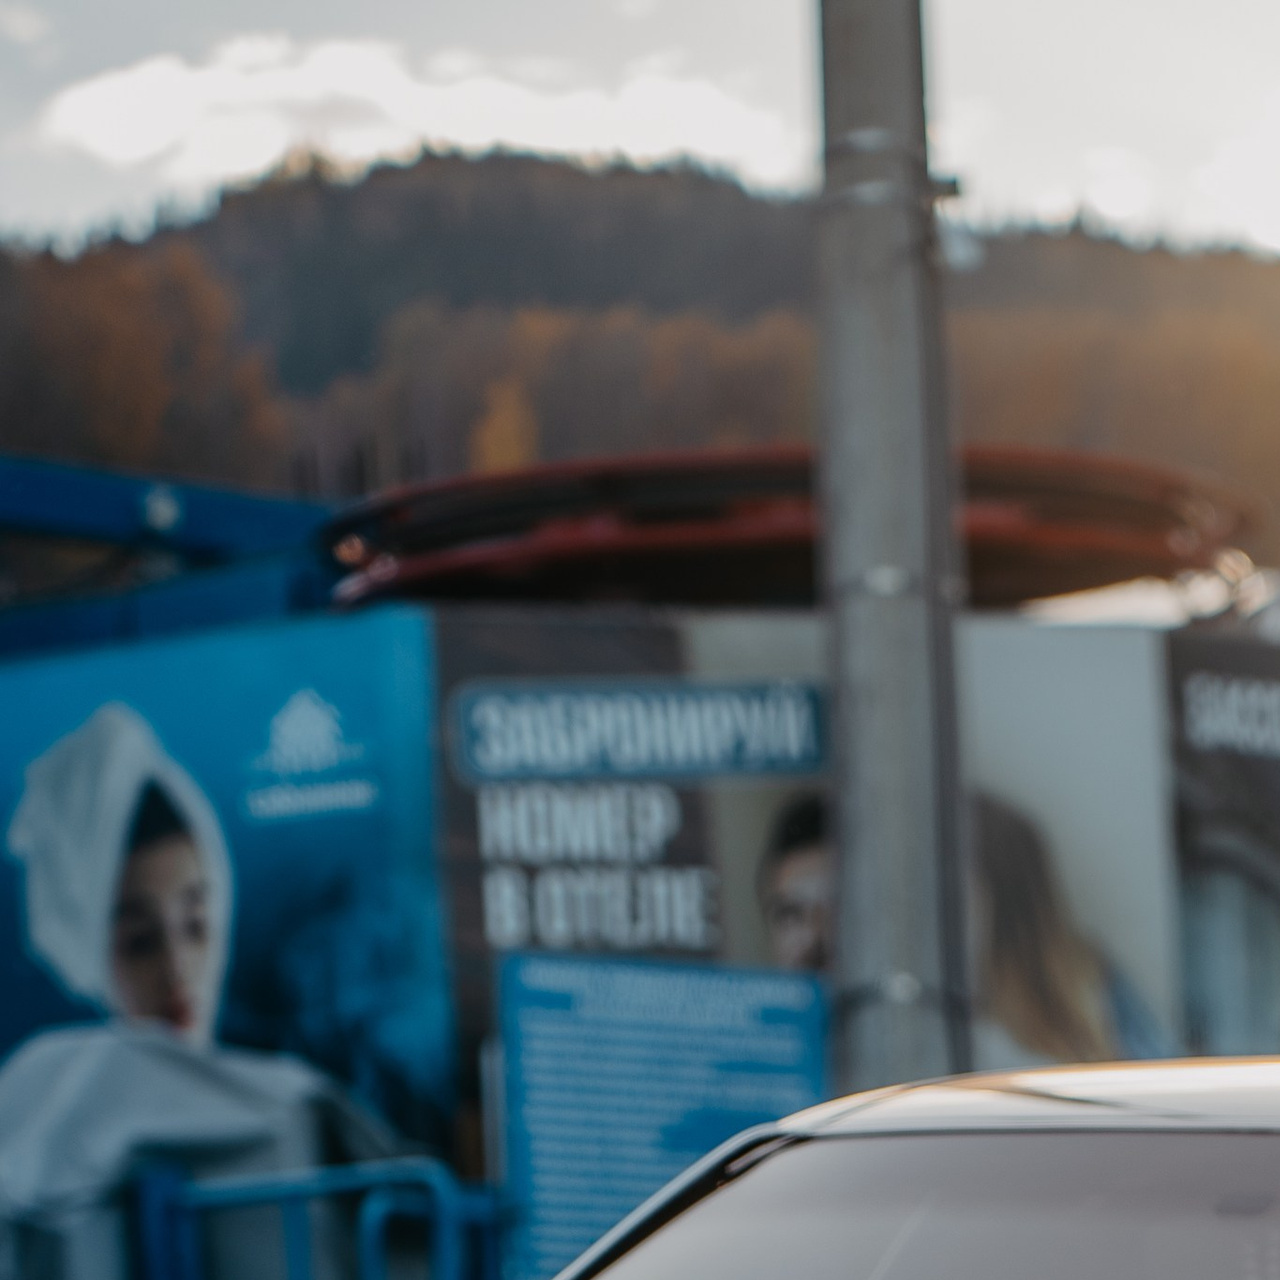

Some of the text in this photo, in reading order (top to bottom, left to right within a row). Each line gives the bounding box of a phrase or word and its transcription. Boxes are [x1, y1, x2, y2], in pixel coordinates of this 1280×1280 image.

[476, 781, 682, 863] НОМЕР
[482, 867, 723, 951] В ОТЕЛЕ
